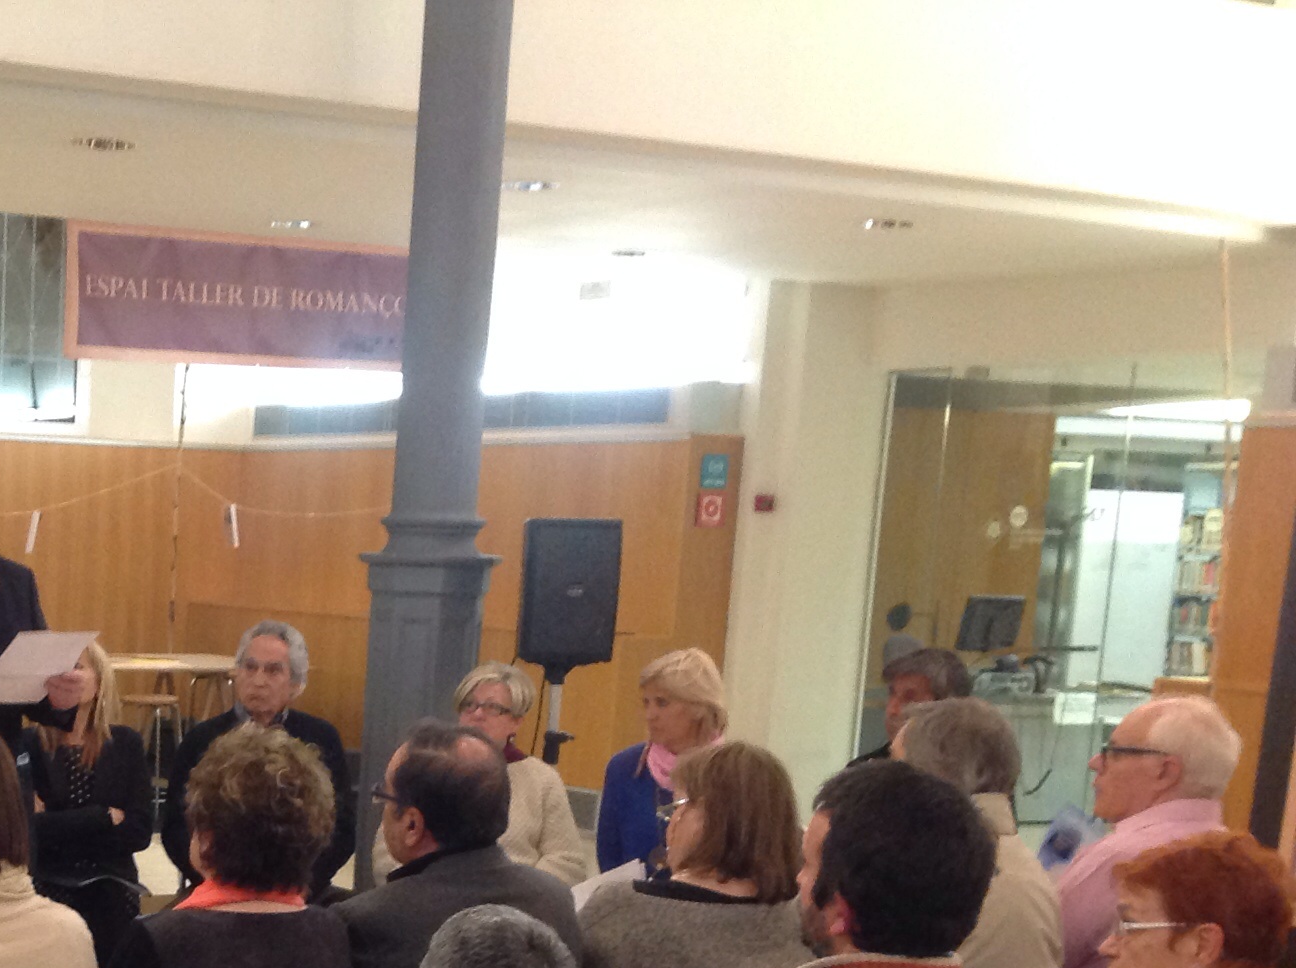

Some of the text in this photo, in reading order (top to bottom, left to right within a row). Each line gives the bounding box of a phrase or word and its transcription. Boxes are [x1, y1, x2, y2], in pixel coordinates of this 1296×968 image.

[85, 273, 149, 300] ESPAI
[156, 277, 245, 307] TALLER
[252, 284, 284, 310] DE
